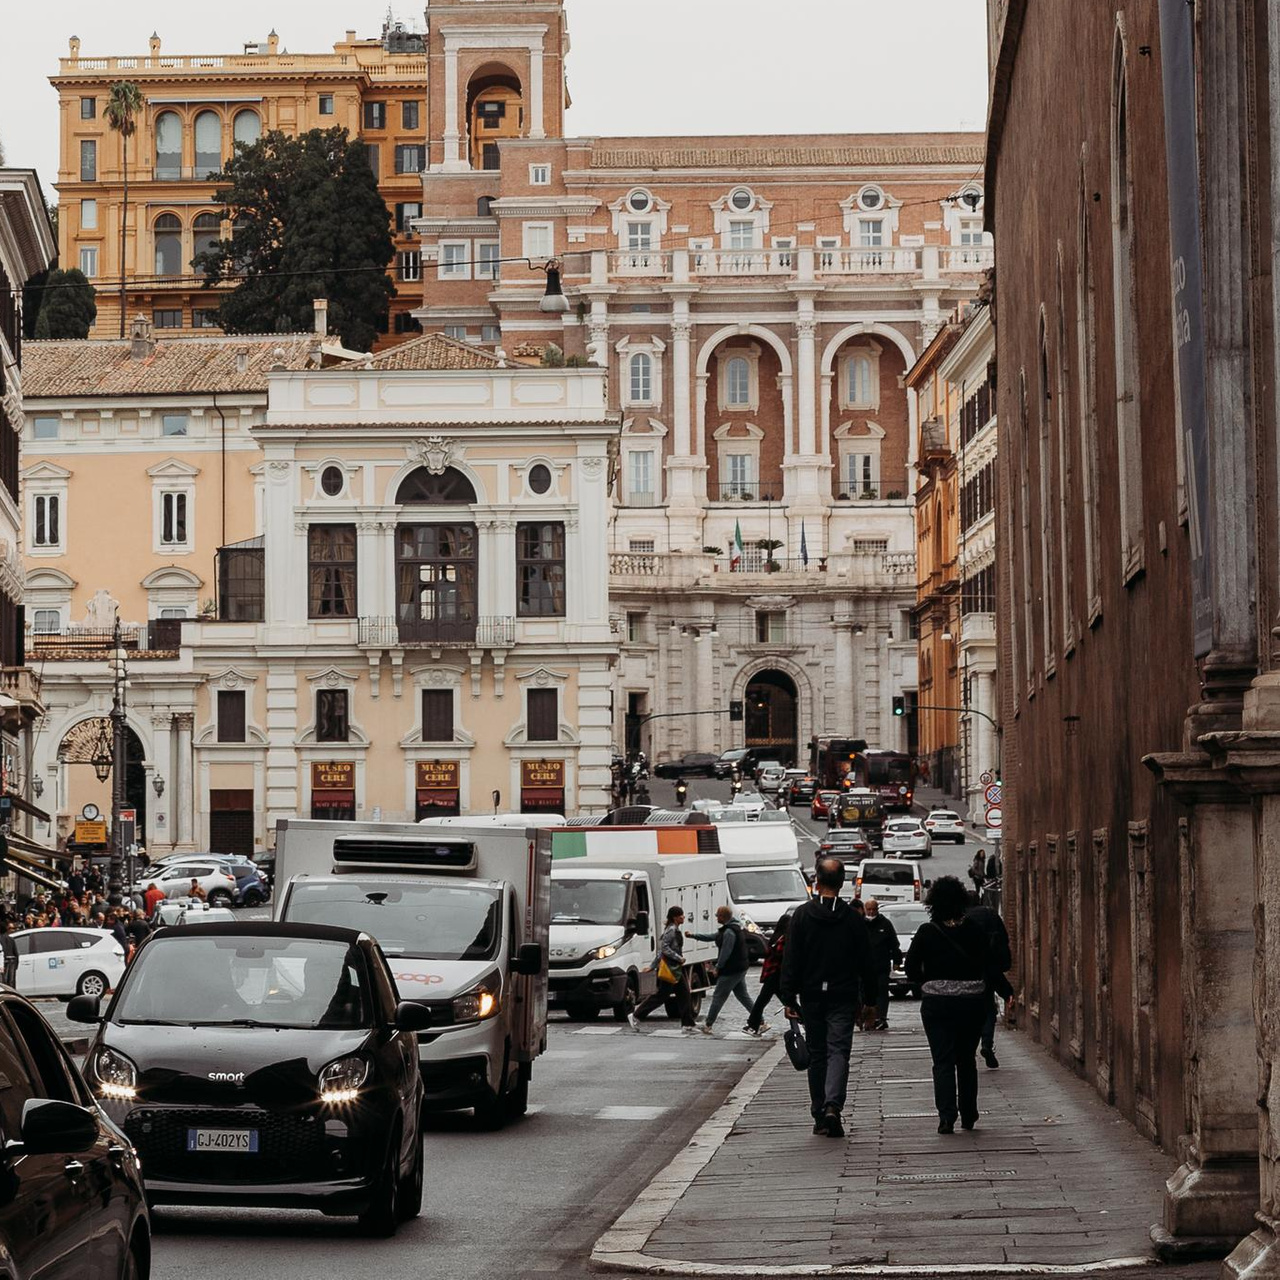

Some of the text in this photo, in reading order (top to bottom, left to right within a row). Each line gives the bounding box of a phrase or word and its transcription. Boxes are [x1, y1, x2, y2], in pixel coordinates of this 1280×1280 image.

[317, 764, 351, 772] MUSEO
[421, 764, 455, 772] MUSEO
[320, 774, 348, 782] CERE
[425, 773, 452, 782] CERE
[530, 772, 557, 780] CERE
[207, 1071, 246, 1082] smart
